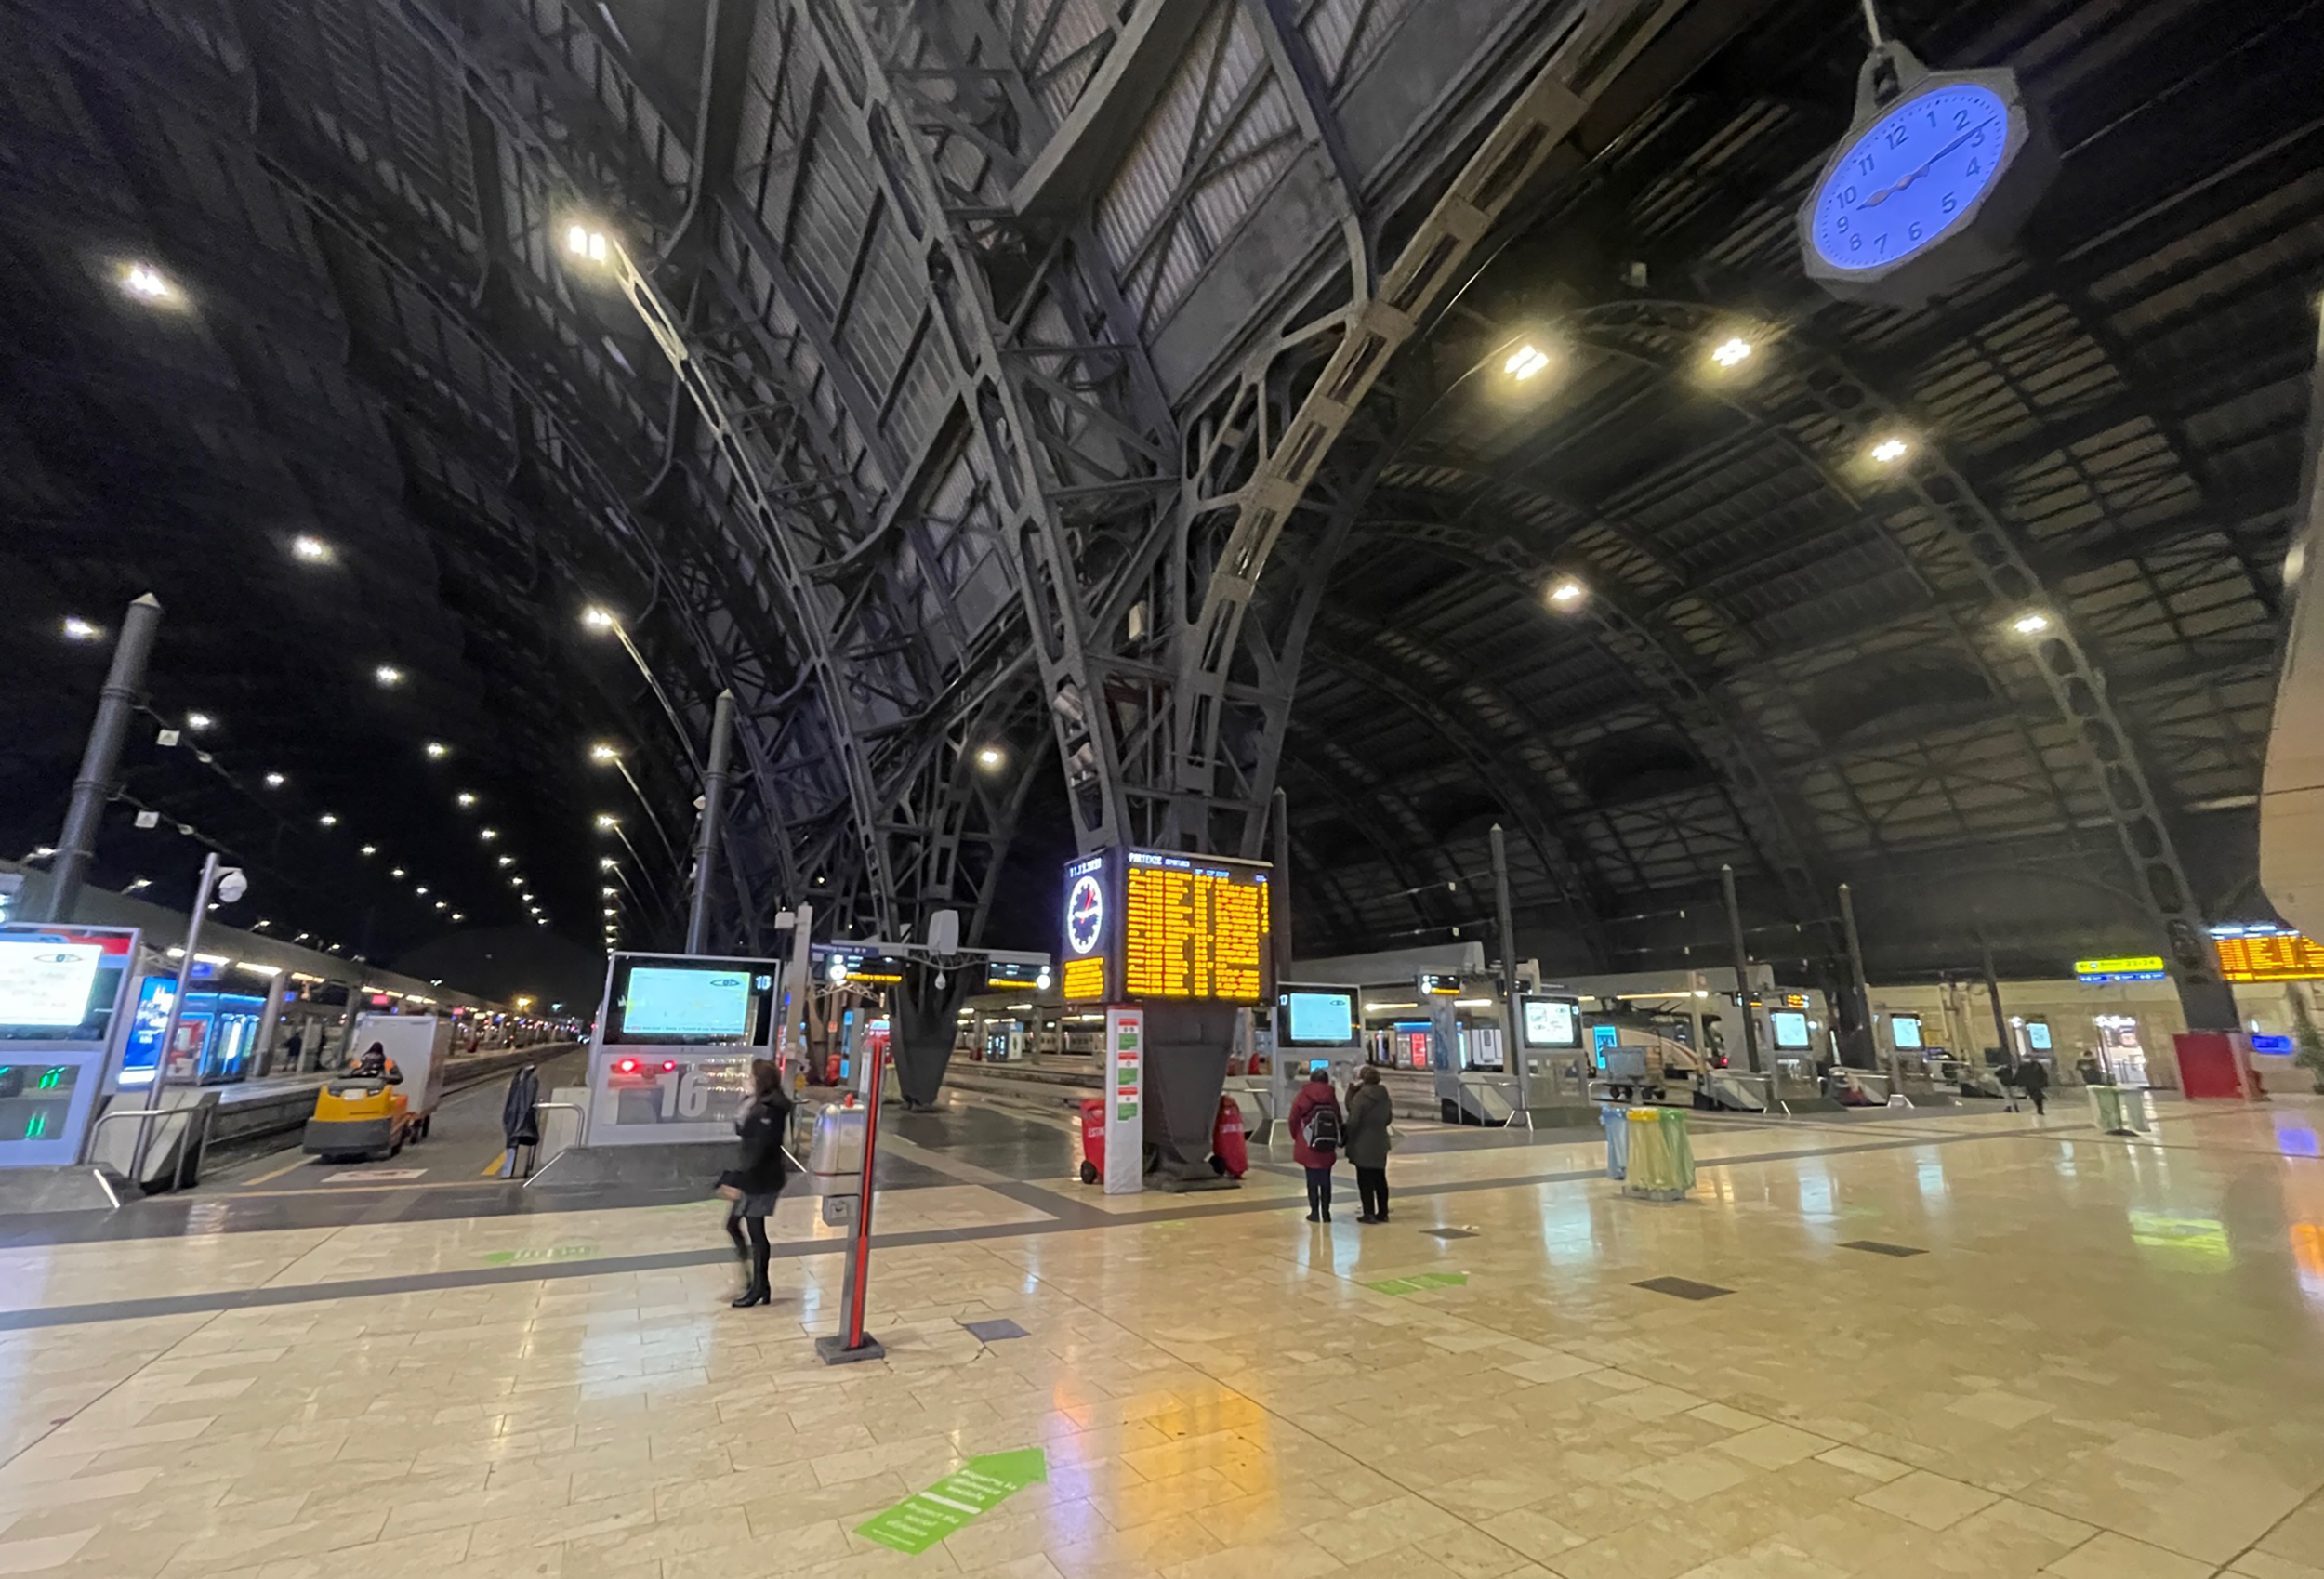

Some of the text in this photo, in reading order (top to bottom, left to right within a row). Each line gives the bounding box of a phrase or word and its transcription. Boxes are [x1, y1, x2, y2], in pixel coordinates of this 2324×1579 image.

[1926, 111, 1936, 128] 1
[1953, 110, 1972, 130] 2
[1885, 125, 1909, 150] 12
[1970, 128, 1986, 149] 3
[1858, 154, 1875, 176] 11
[1966, 157, 1981, 178] 4
[1837, 186, 1857, 209] 10
[1942, 192, 1958, 215] 5
[1836, 216, 1850, 234] 9
[1908, 221, 1922, 241] 6
[1849, 233, 1862, 252] 8
[1874, 234, 1888, 254] 7
[657, 1070, 708, 1117] 16
